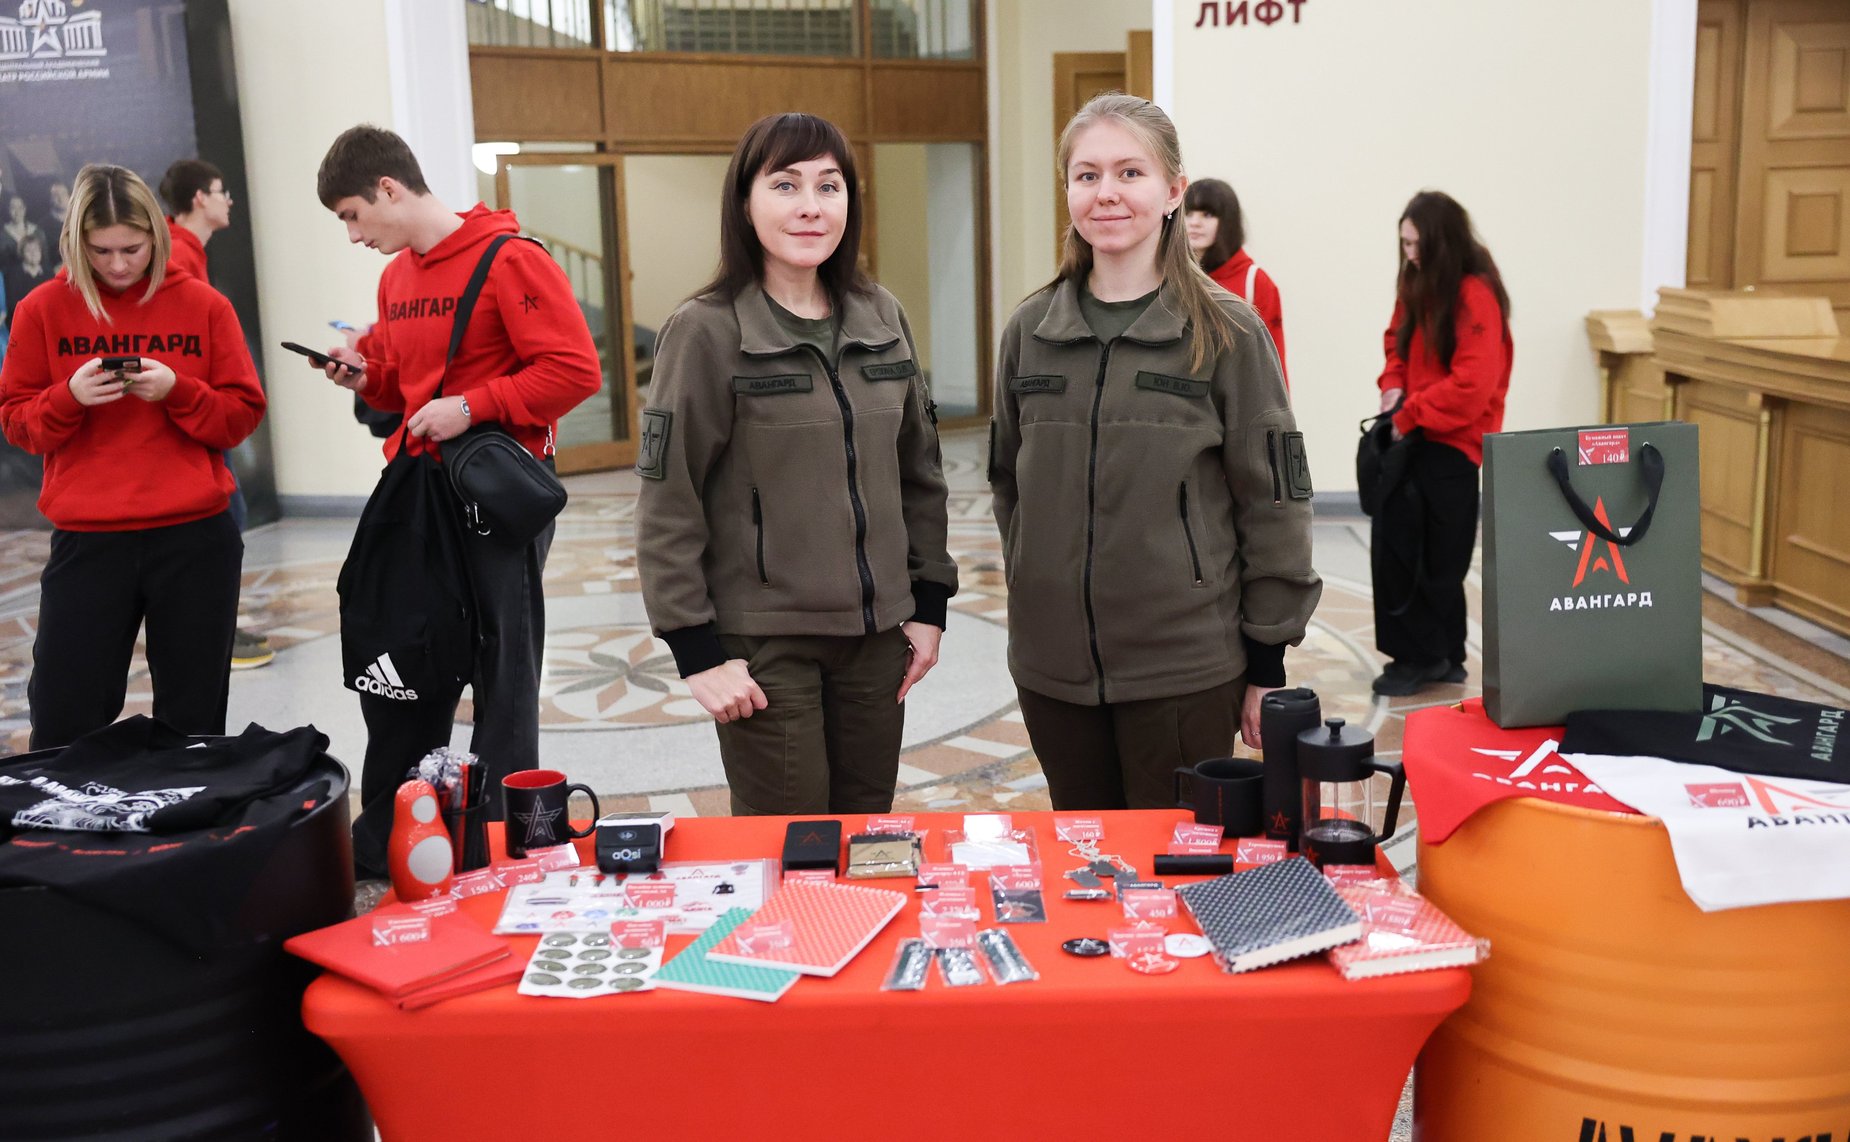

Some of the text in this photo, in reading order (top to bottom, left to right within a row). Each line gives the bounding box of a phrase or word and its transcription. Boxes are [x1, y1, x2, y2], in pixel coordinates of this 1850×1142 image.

[1195, 0, 1307, 27] ЛИФТ
[387, 297, 462, 321] ВАНГАР
[58, 334, 202, 357] АВАНГАРД
[749, 377, 797, 390] АВАНГАРД
[1550, 592, 1652, 611] АВАНГАРД
[355, 675, 419, 701] adidas
[1810, 710, 1845, 762] АВАНГАРД
[612, 848, 641, 861] aQsi
